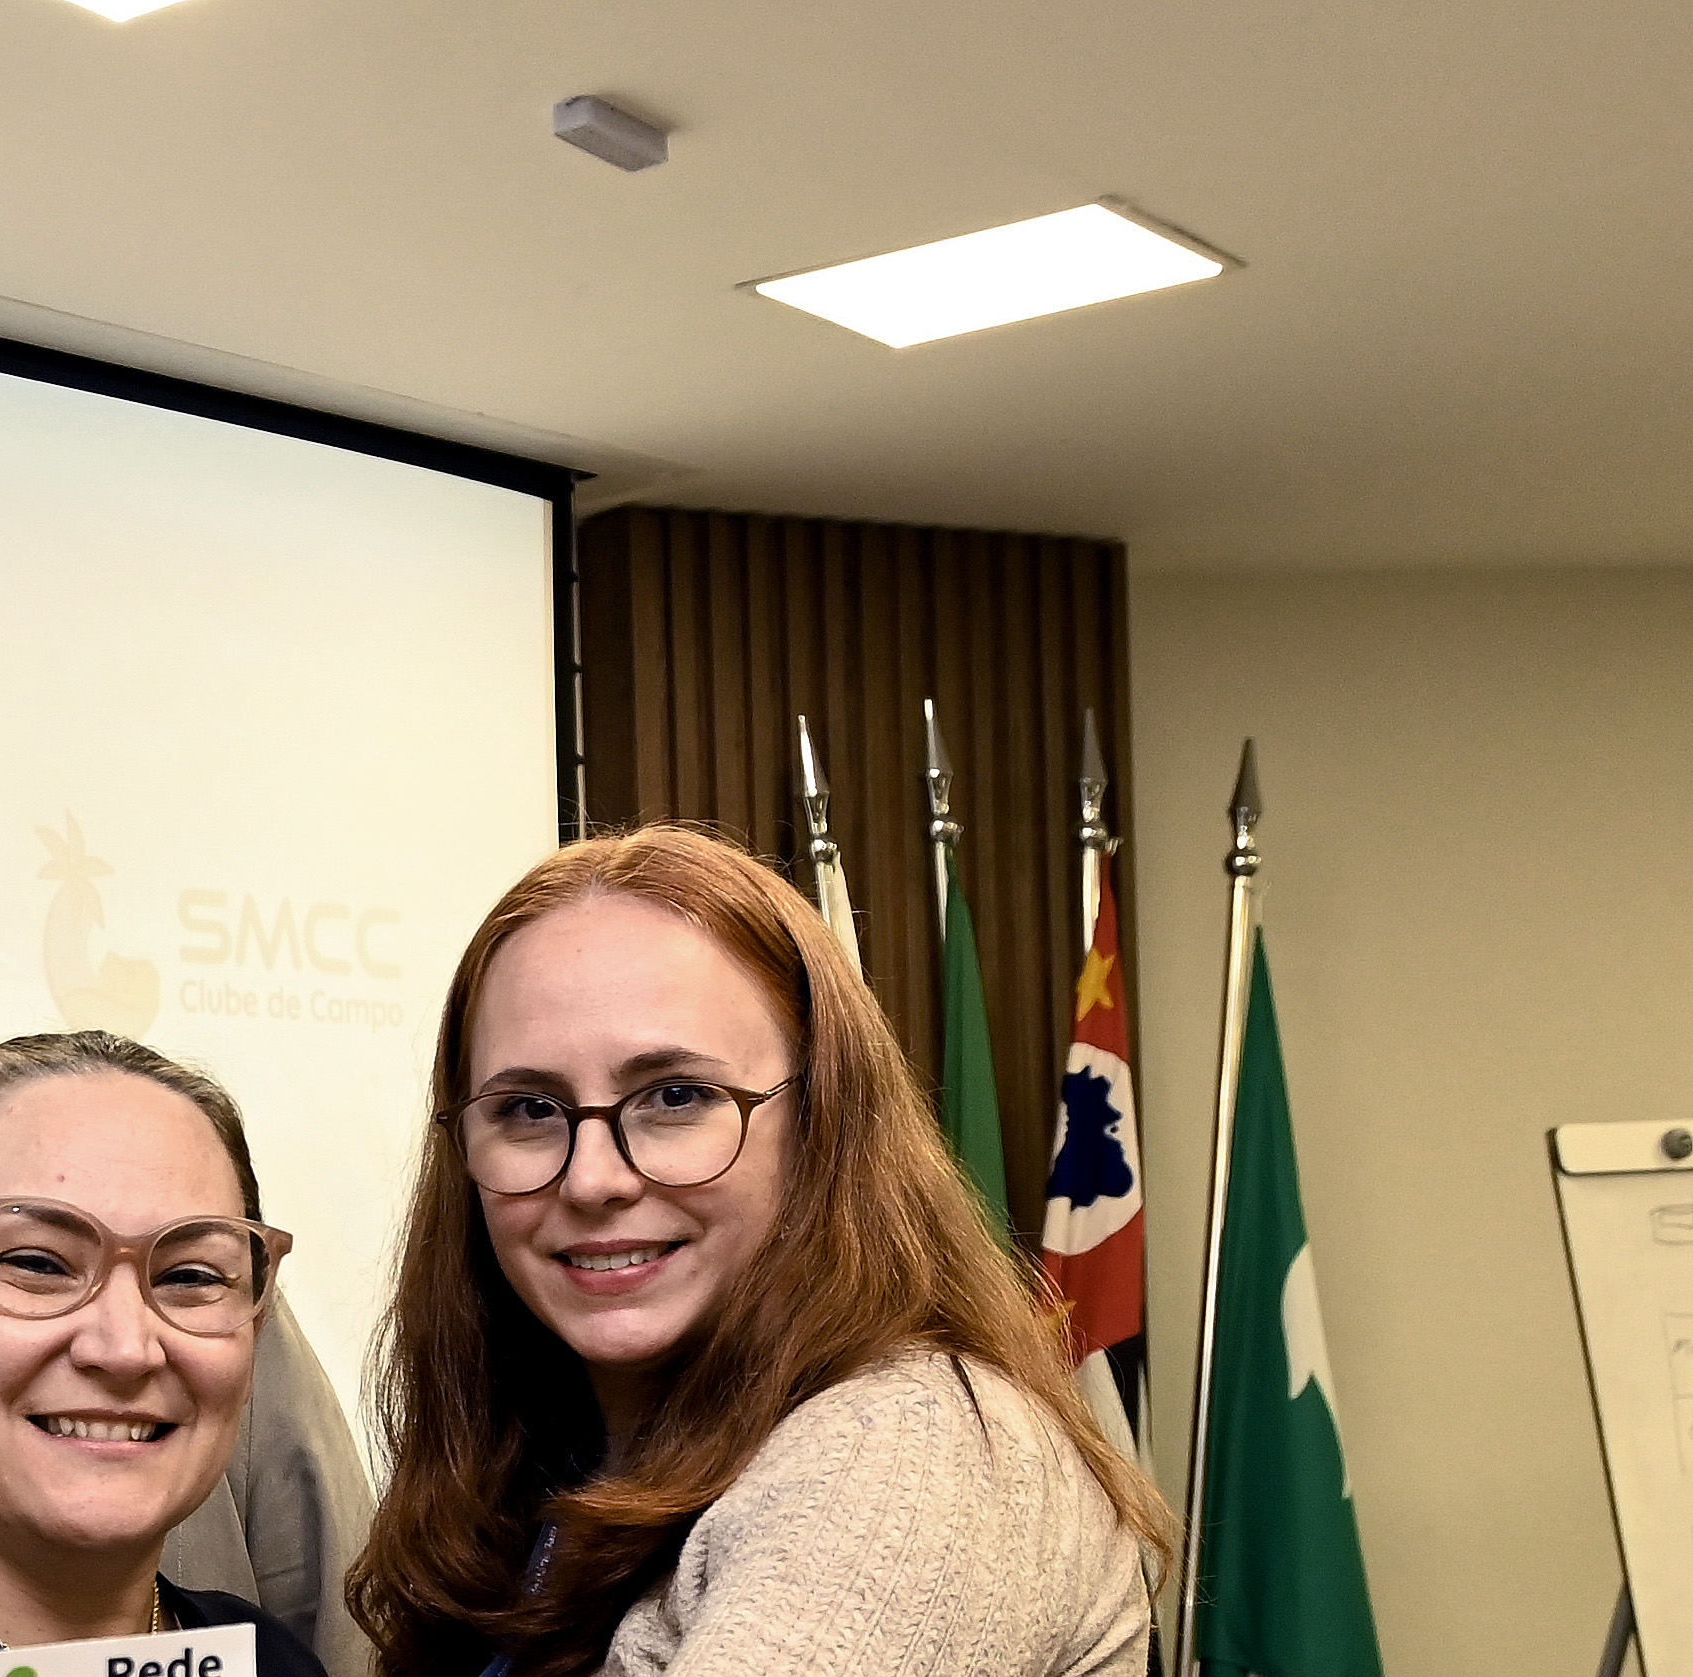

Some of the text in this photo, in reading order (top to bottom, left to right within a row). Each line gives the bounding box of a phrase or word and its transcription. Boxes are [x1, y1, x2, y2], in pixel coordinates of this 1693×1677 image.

[178, 888, 402, 980] SMCC
[179, 978, 403, 1033] Clube de Campo
